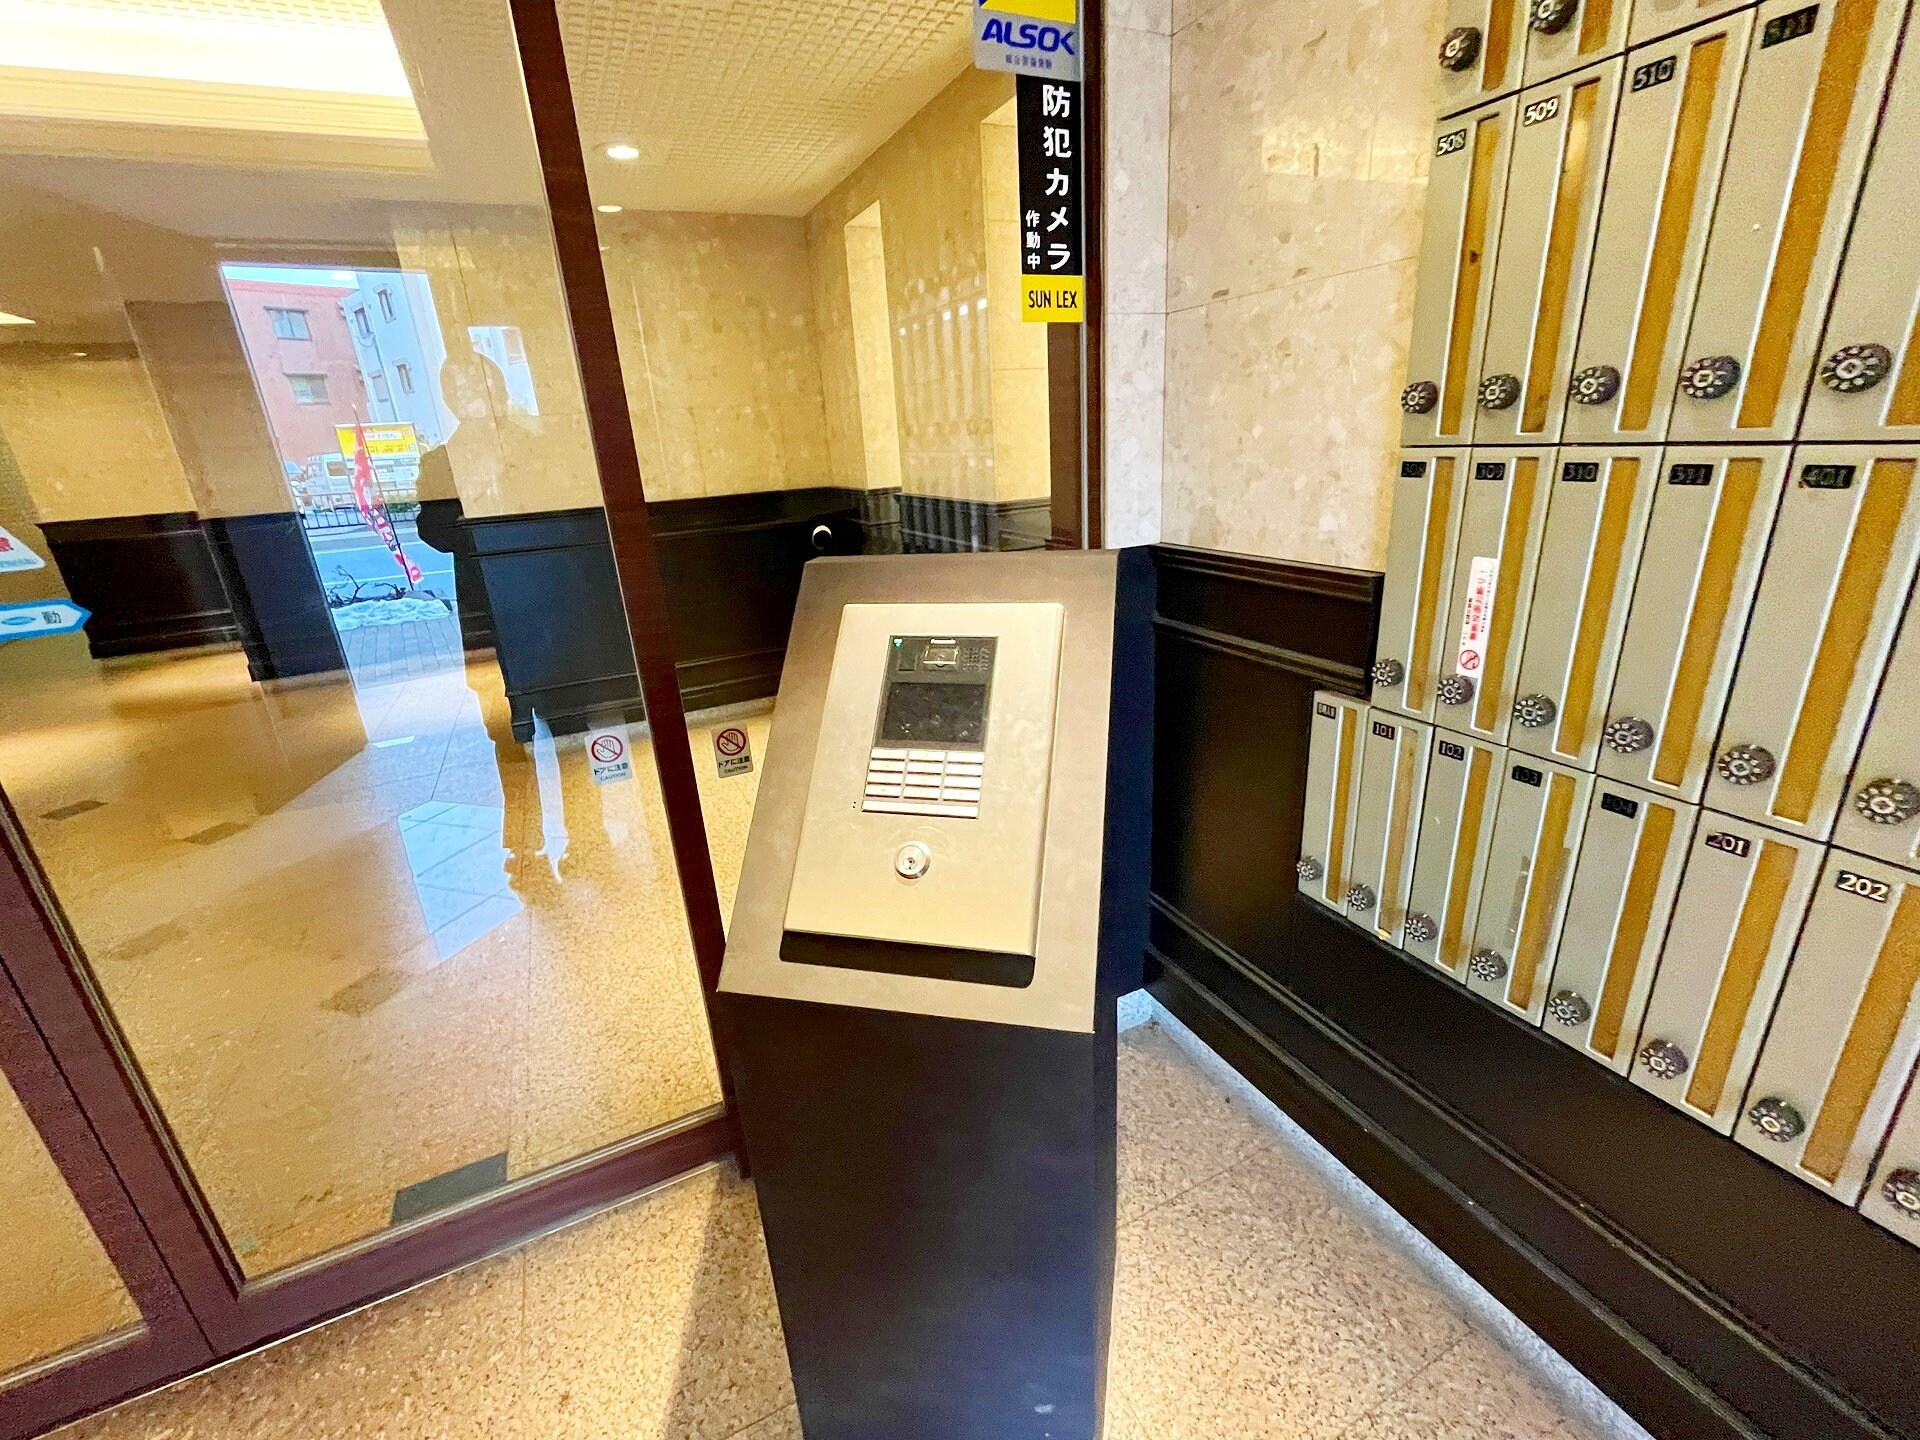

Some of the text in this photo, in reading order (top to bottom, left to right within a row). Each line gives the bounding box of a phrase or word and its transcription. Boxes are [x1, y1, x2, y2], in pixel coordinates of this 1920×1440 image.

[982, 18, 1075, 55] ALSOK
[1633, 58, 1676, 90] 510
[1524, 98, 1559, 125] 509
[1437, 131, 1465, 155] 508
[1042, 84, 1072, 271] 防犯カメラ
[1026, 209, 1041, 270] 作動中
[1028, 290, 1078, 308] SUN LEX
[1564, 464, 1597, 481] 310
[1804, 467, 1850, 487] 401
[1375, 724, 1393, 739] 101
[1440, 742, 1463, 758] 102
[600, 772, 626, 781] CAUTION
[724, 765, 748, 774] CAUTION
[1708, 835, 1746, 855] 201
[1838, 873, 1889, 901] 202
